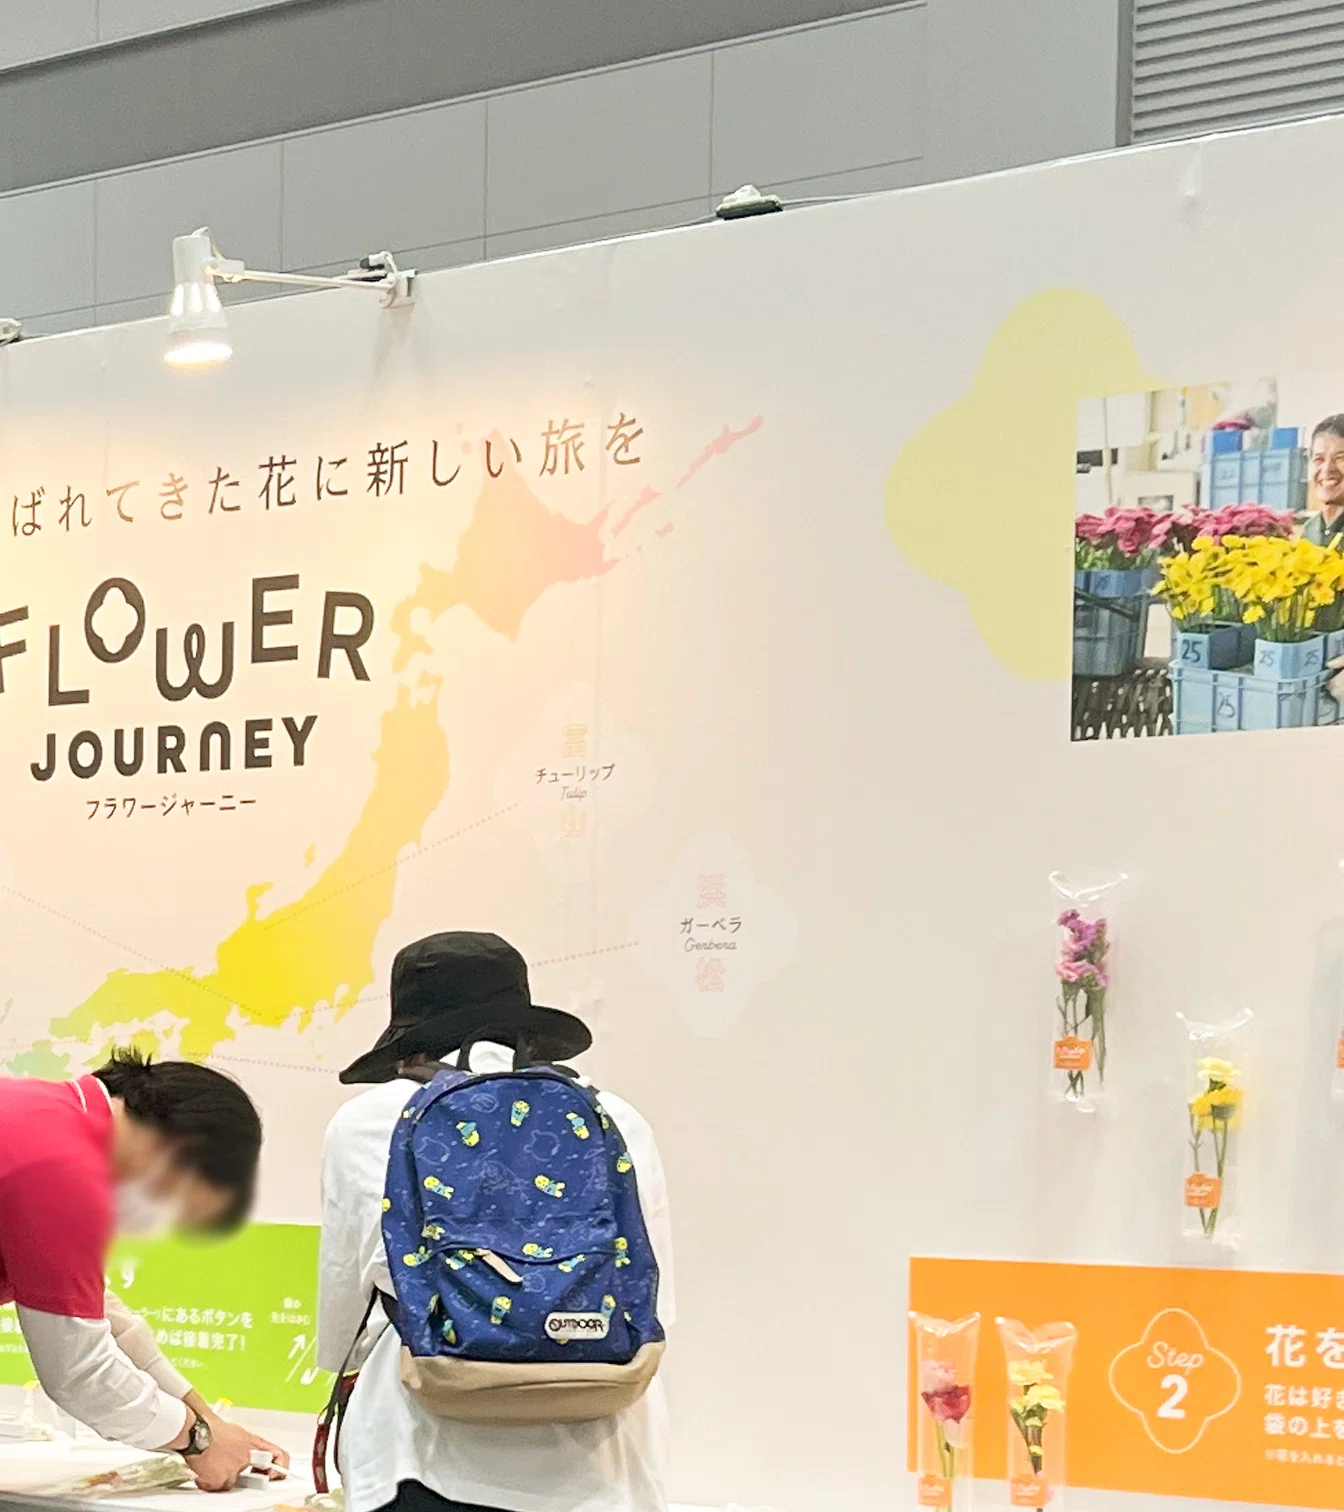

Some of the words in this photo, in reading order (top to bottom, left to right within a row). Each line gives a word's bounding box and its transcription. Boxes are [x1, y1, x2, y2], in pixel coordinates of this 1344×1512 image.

[1181, 638, 1204, 663] 25
[30, 715, 318, 781] JOURNEY
[535, 762, 617, 785] チューリップ
[85, 793, 256, 820] フラワージャーニー
[679, 915, 743, 934] ガーベラ
[683, 936, 738, 953] Gerbera
[1146, 1341, 1205, 1375] Step
[1156, 1375, 1189, 1419] 2
